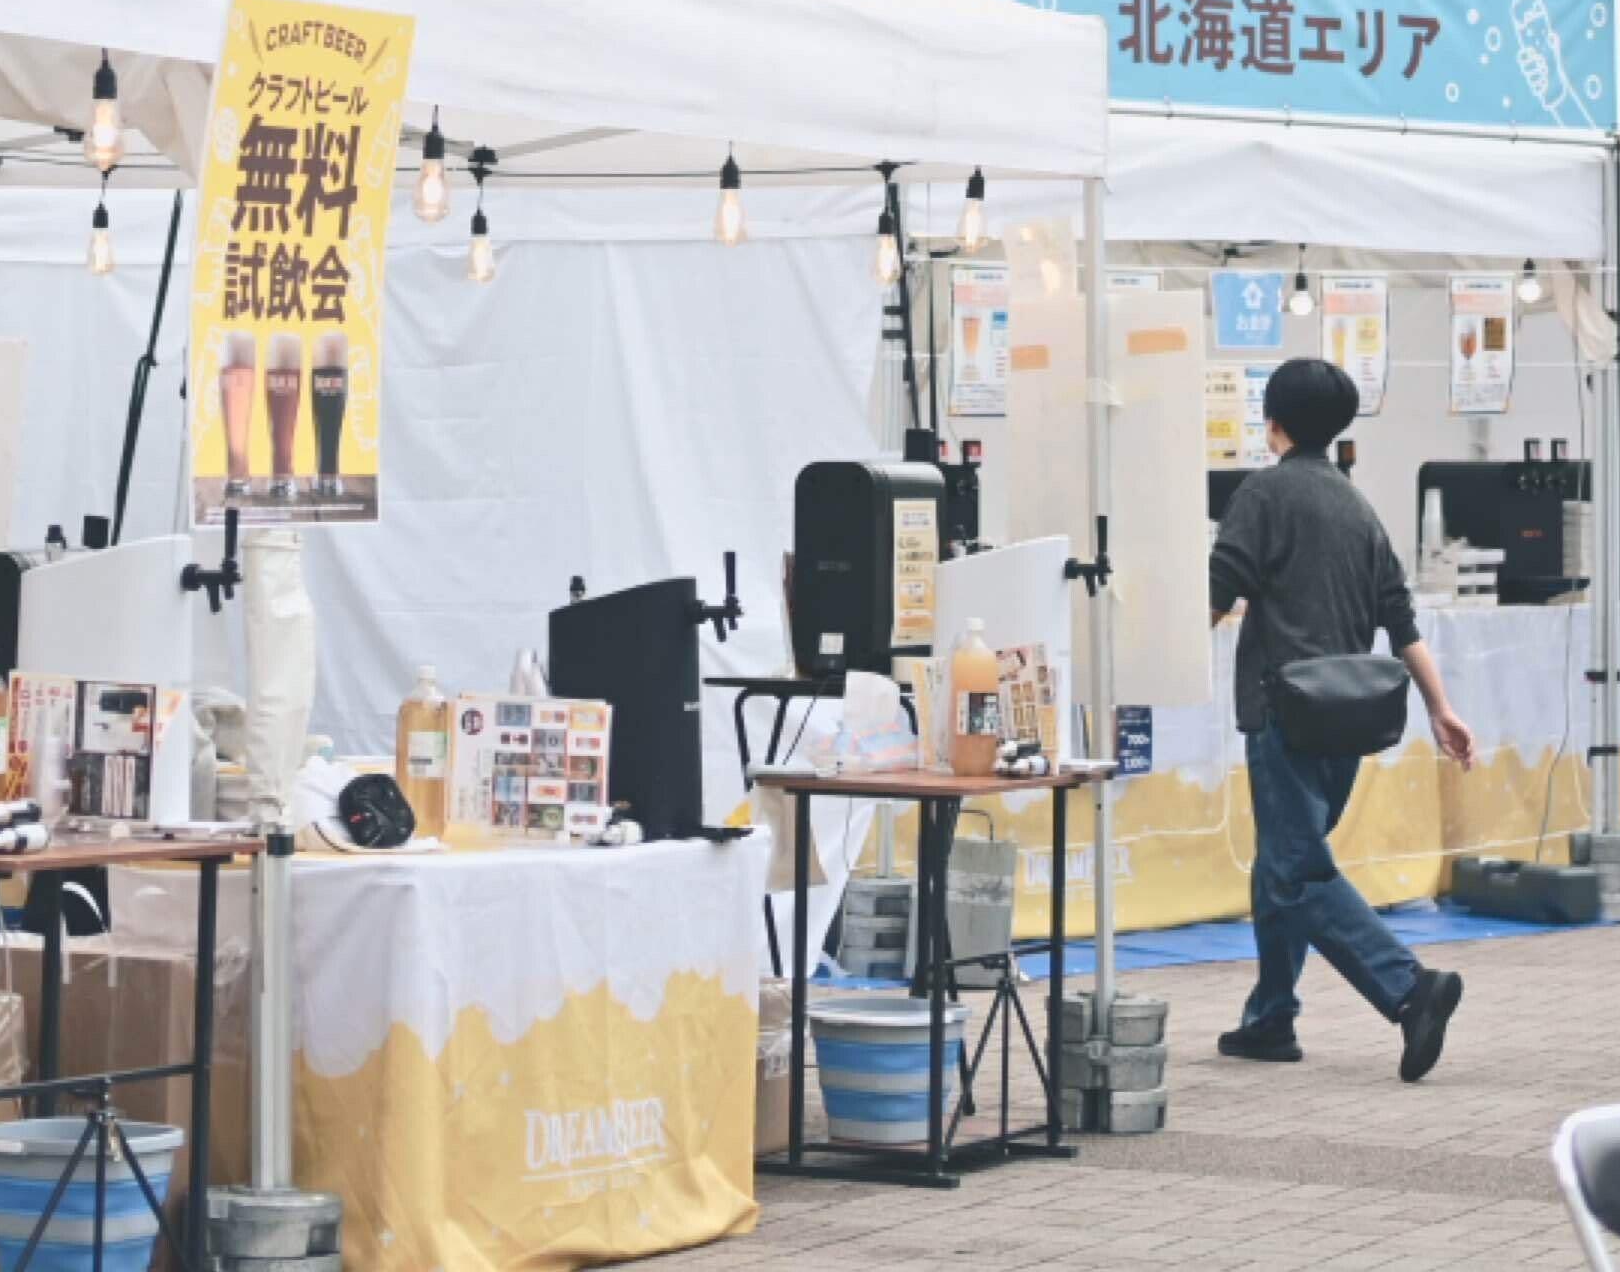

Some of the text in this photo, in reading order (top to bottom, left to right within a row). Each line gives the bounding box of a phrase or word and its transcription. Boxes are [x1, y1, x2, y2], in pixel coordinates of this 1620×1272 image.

[247, 71, 370, 115] クラフトビール
[230, 113, 361, 240] 無料
[222, 241, 350, 324] 試飲会
